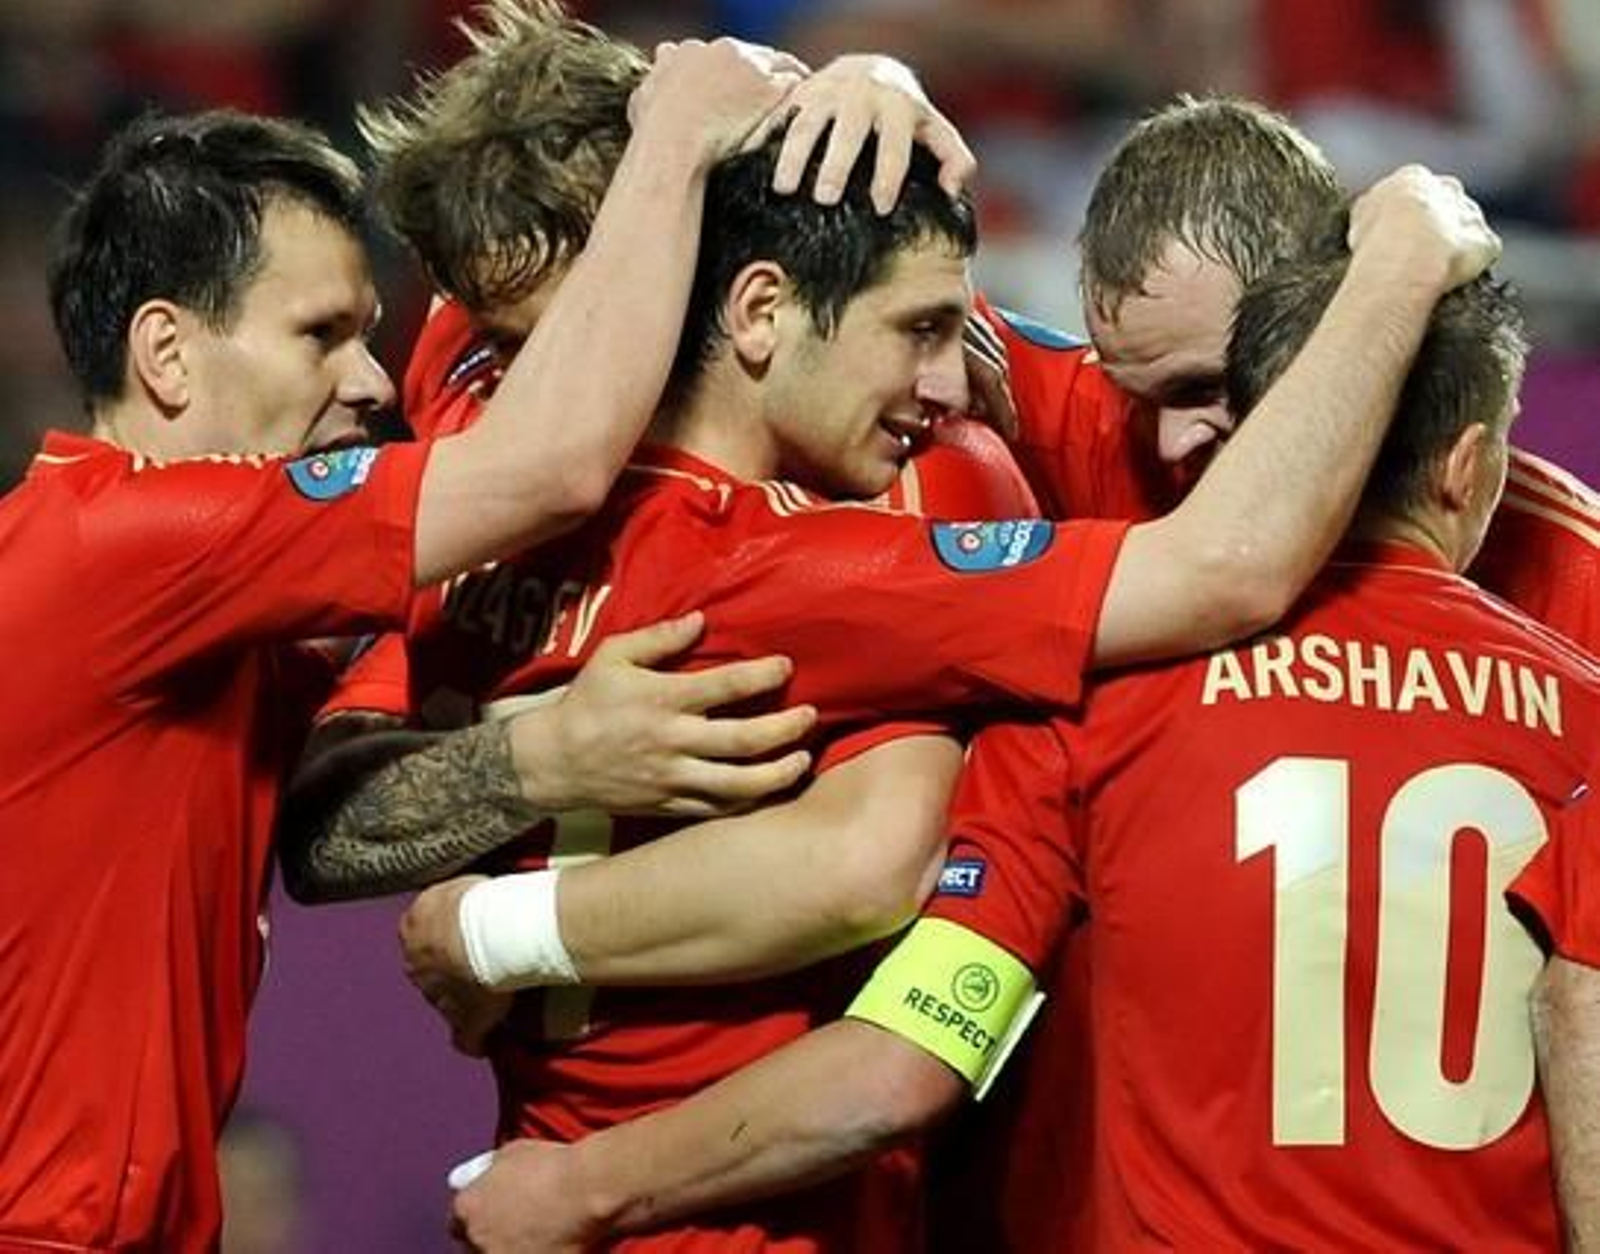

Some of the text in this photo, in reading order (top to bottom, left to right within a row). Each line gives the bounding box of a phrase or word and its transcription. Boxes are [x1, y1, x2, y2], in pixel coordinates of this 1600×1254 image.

[1202, 634, 1563, 737] ARSHAVIN
[938, 867, 980, 888] ECT
[1235, 755, 1550, 1152] 10
[903, 987, 997, 1056] RESPECT
